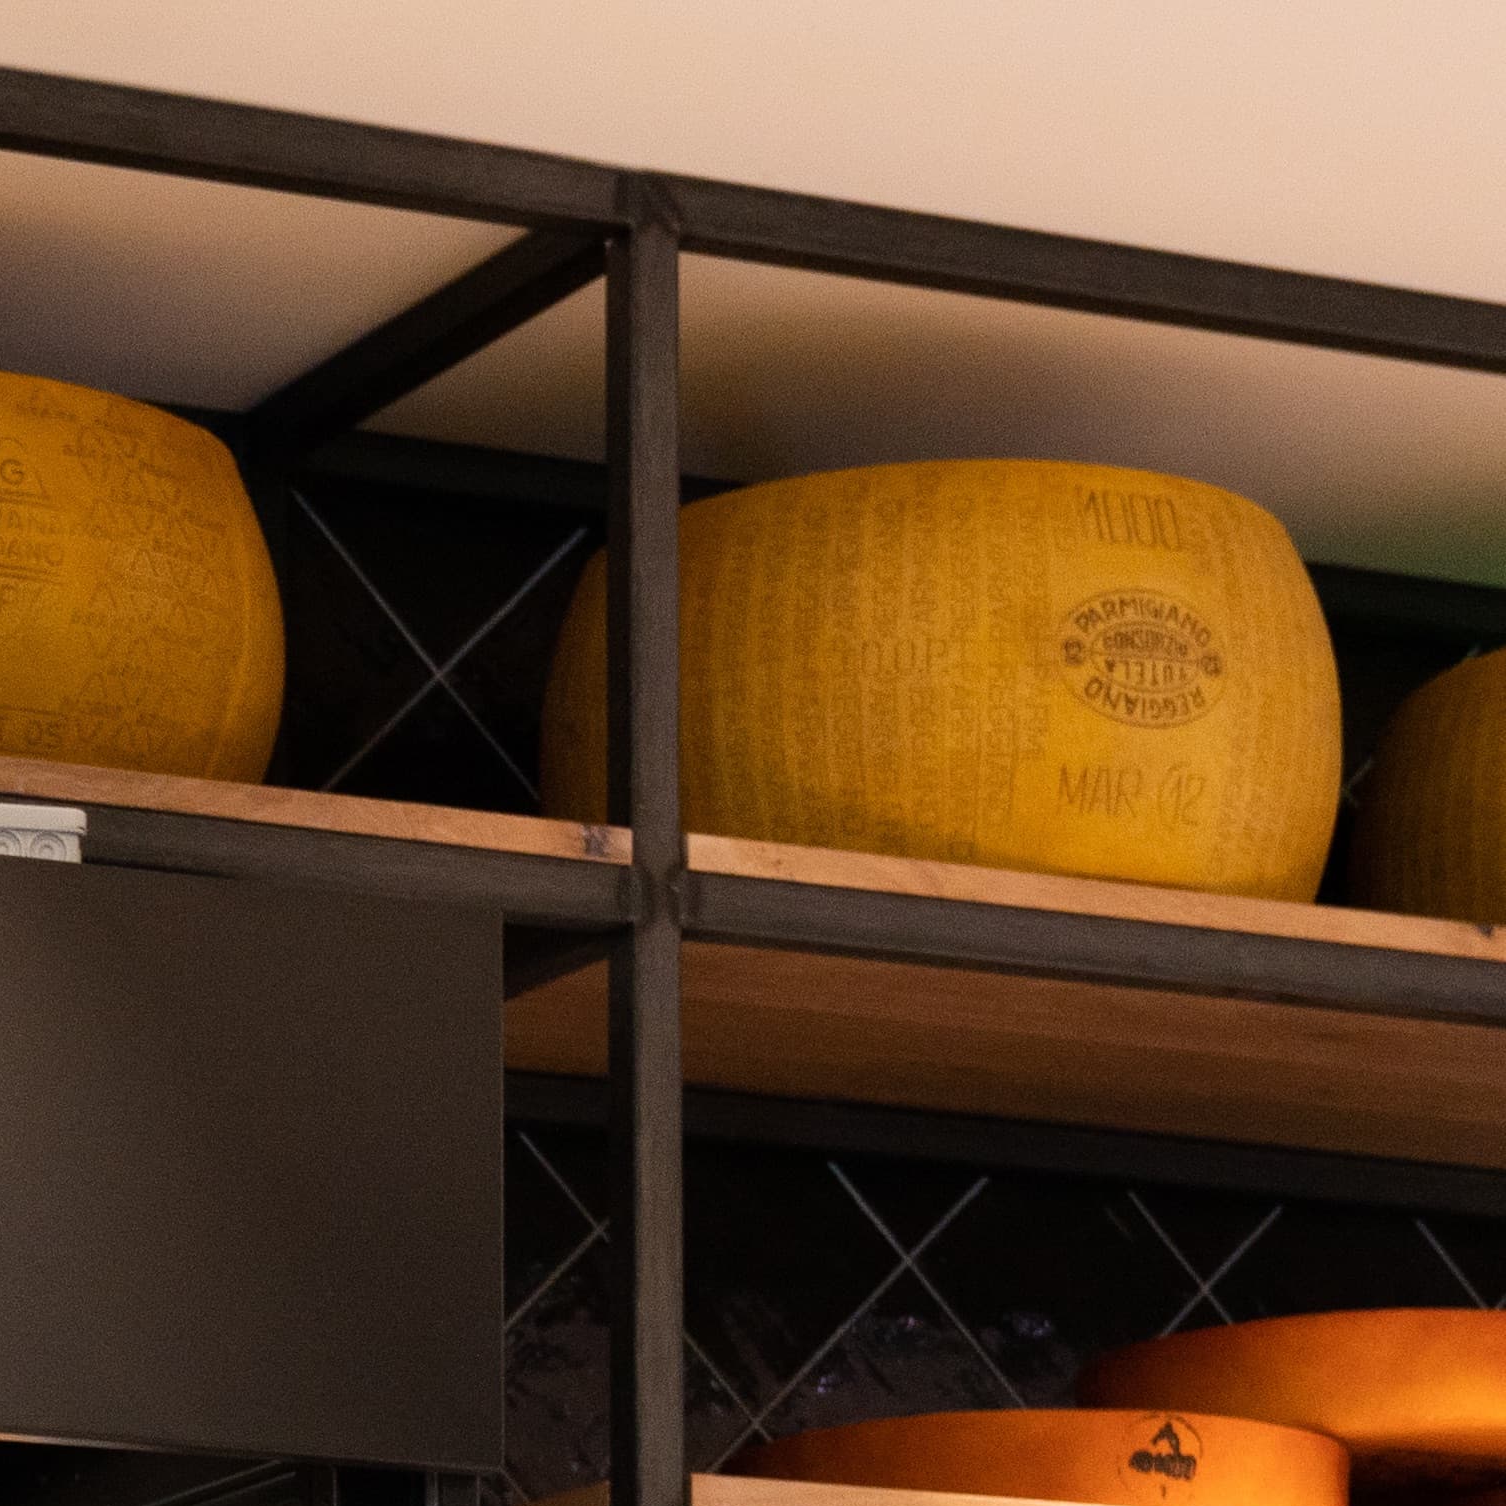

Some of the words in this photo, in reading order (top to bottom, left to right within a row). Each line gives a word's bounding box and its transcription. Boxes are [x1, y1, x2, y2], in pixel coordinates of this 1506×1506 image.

[1075, 595, 1213, 649] PARMIGIANO
[1084, 673, 1208, 722] REGGIANO
[1057, 763, 1144, 820] MAR
